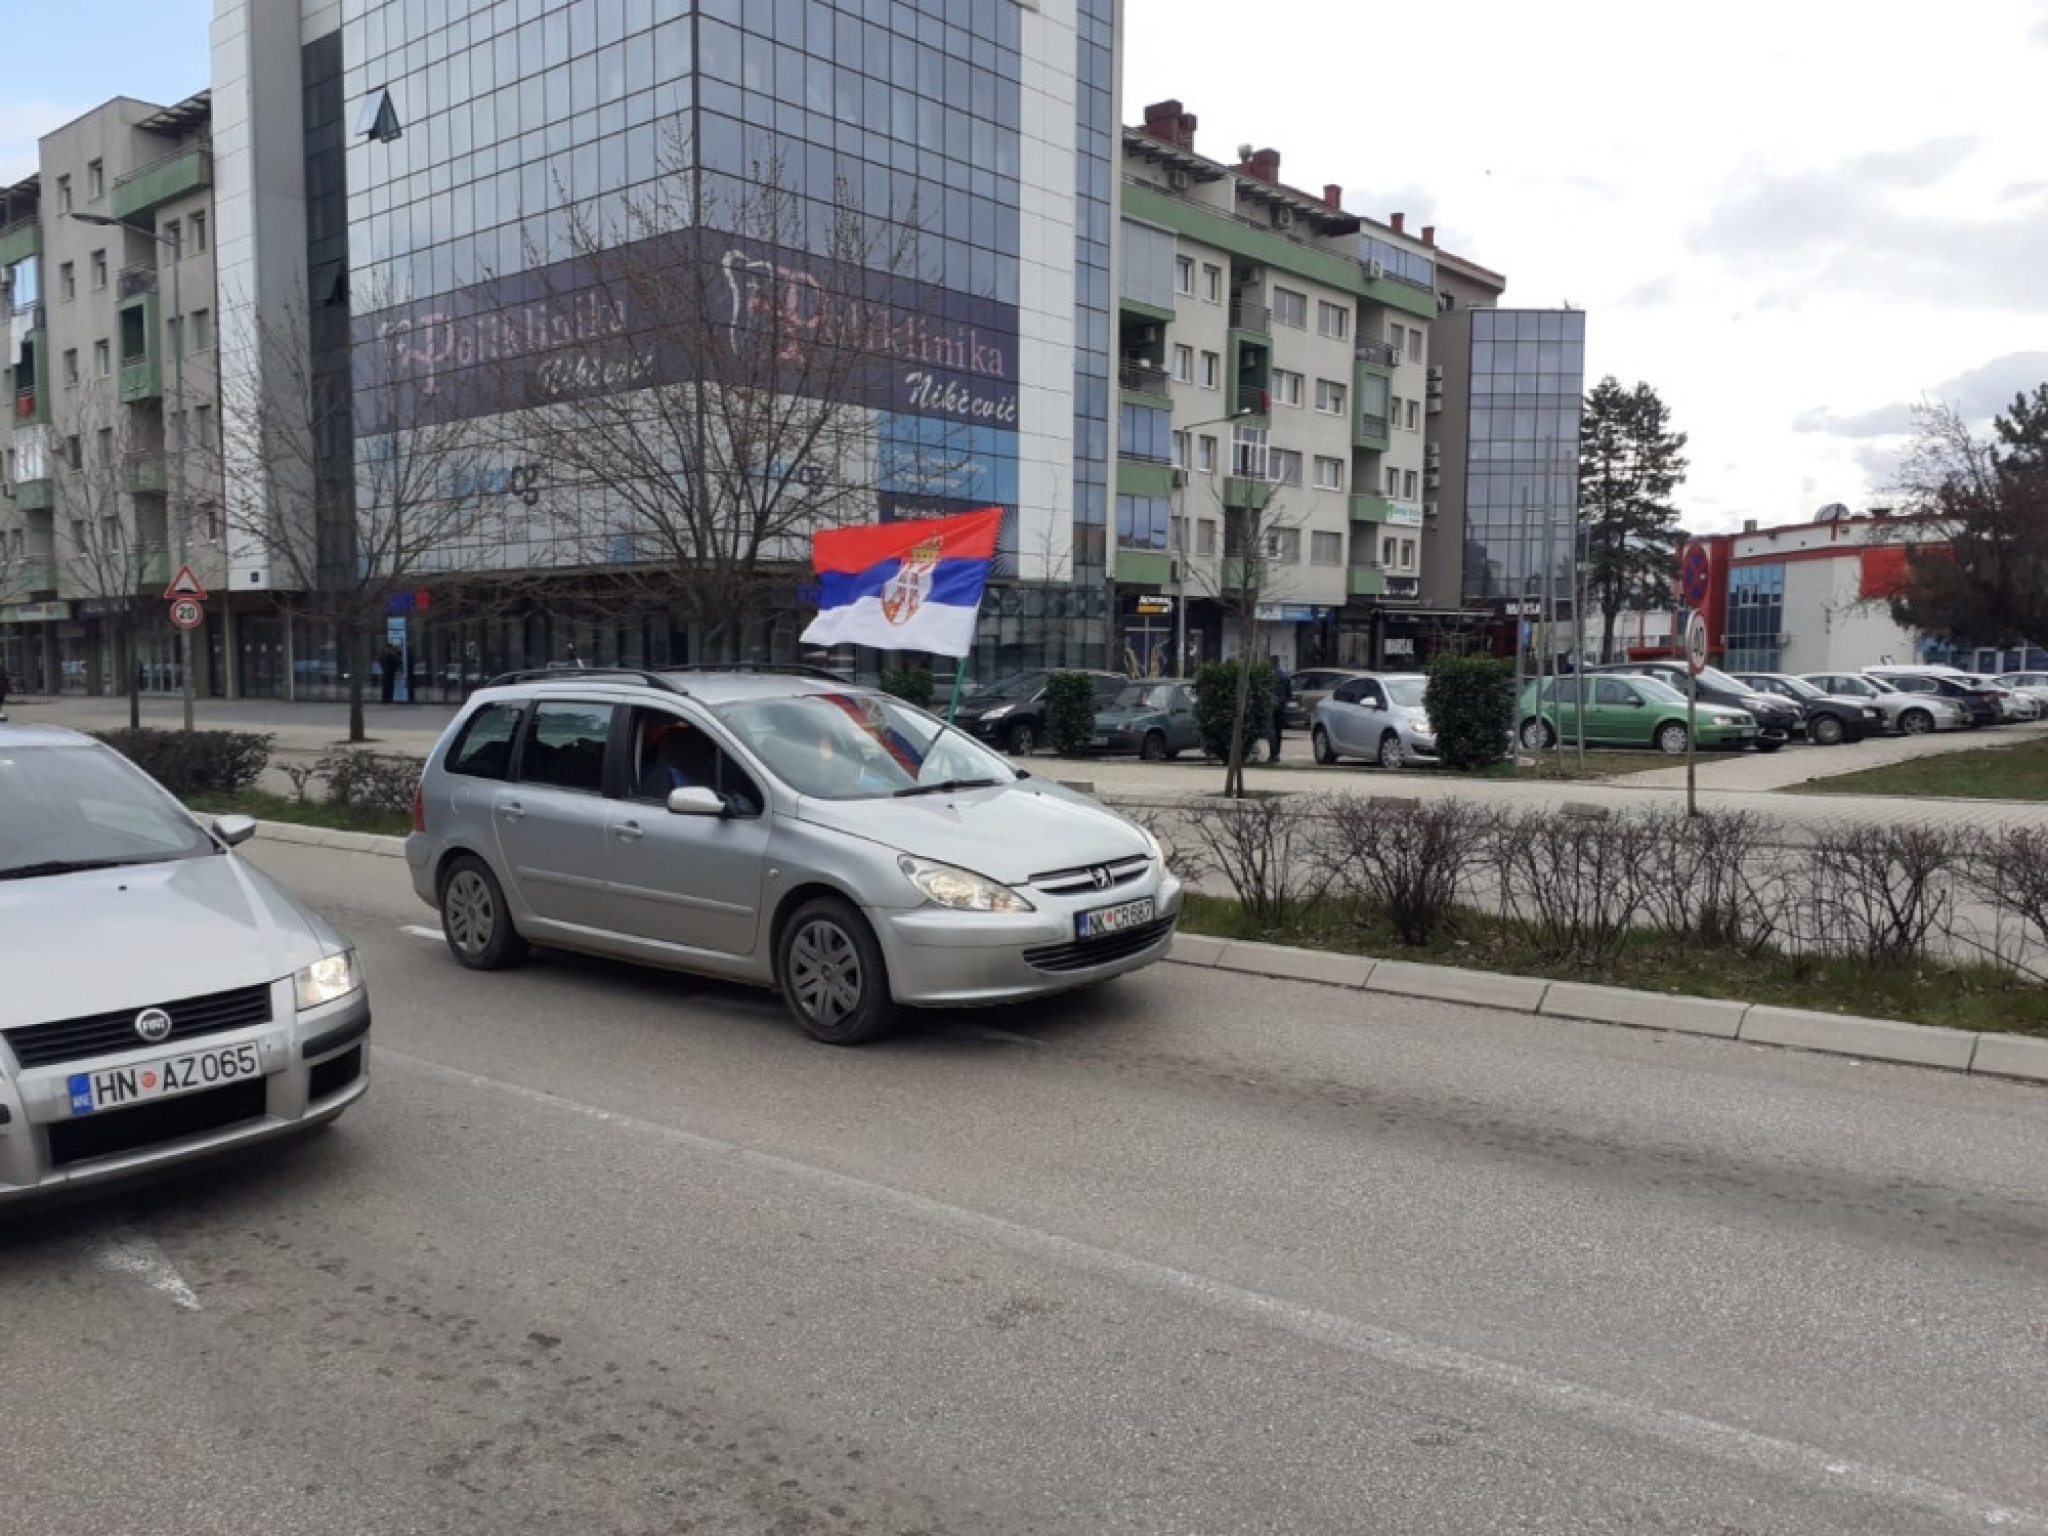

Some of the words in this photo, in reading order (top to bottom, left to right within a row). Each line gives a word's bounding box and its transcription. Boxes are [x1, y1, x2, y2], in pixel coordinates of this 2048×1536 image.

[905, 371, 1017, 423] Nikčević
[179, 606, 195, 620] 20
[95, 1069, 138, 1105] HN
[163, 1046, 256, 1091] AZ065
